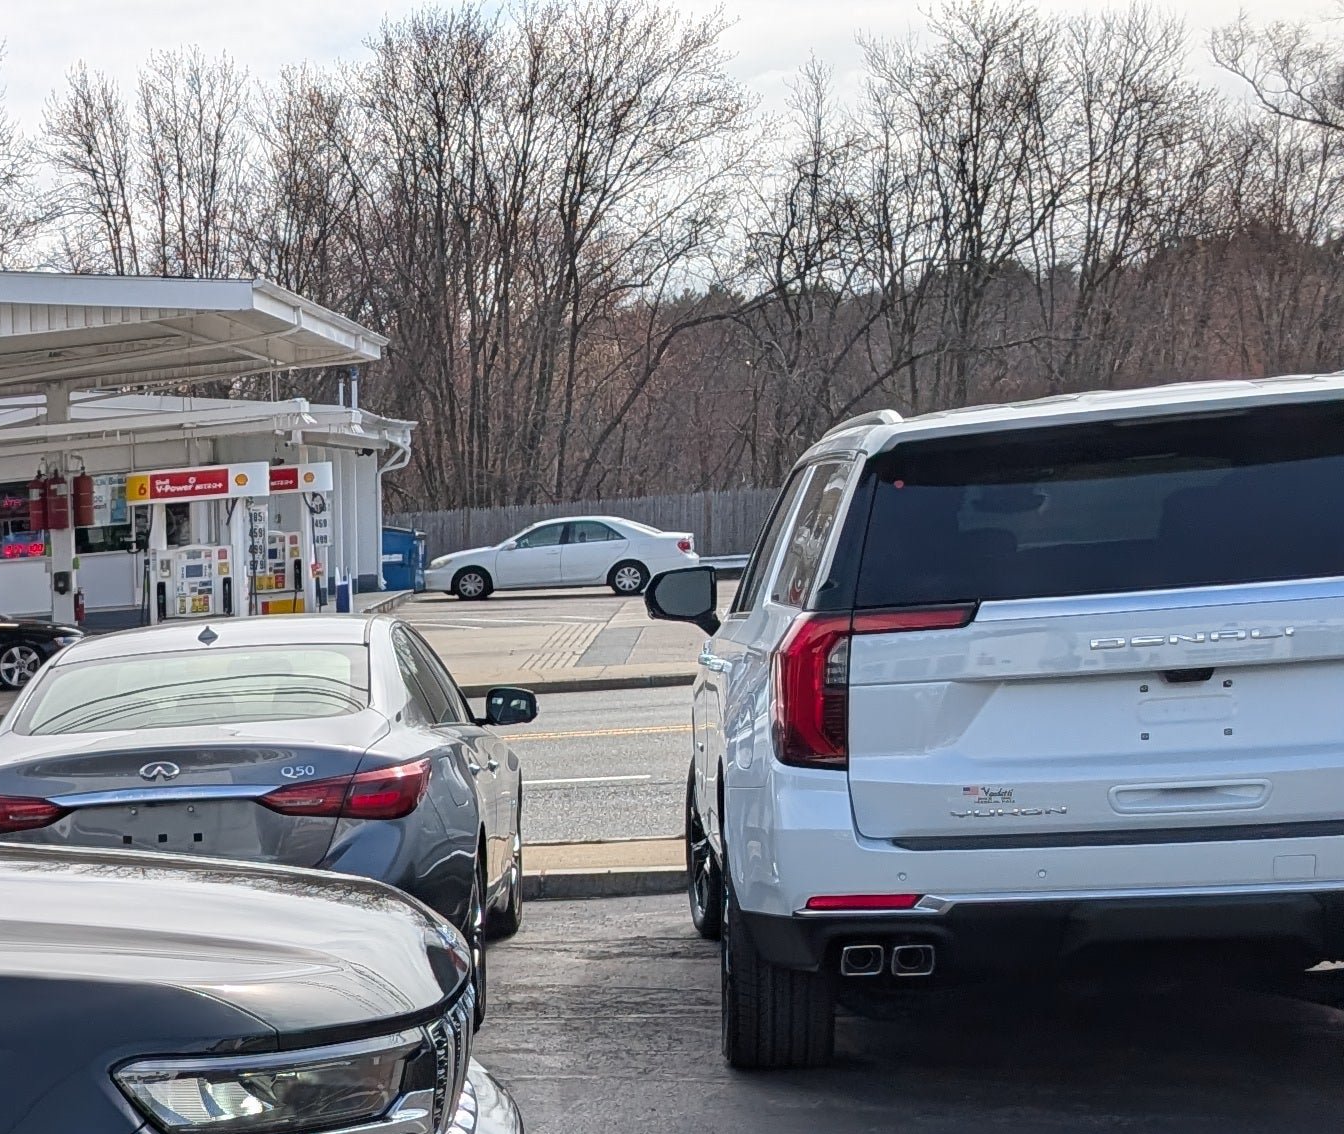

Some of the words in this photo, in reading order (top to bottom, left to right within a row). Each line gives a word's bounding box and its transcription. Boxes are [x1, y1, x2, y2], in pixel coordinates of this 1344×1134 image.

[138, 483, 147, 496] 6
[1089, 625, 1295, 650] DENALI
[280, 765, 315, 779] Q50
